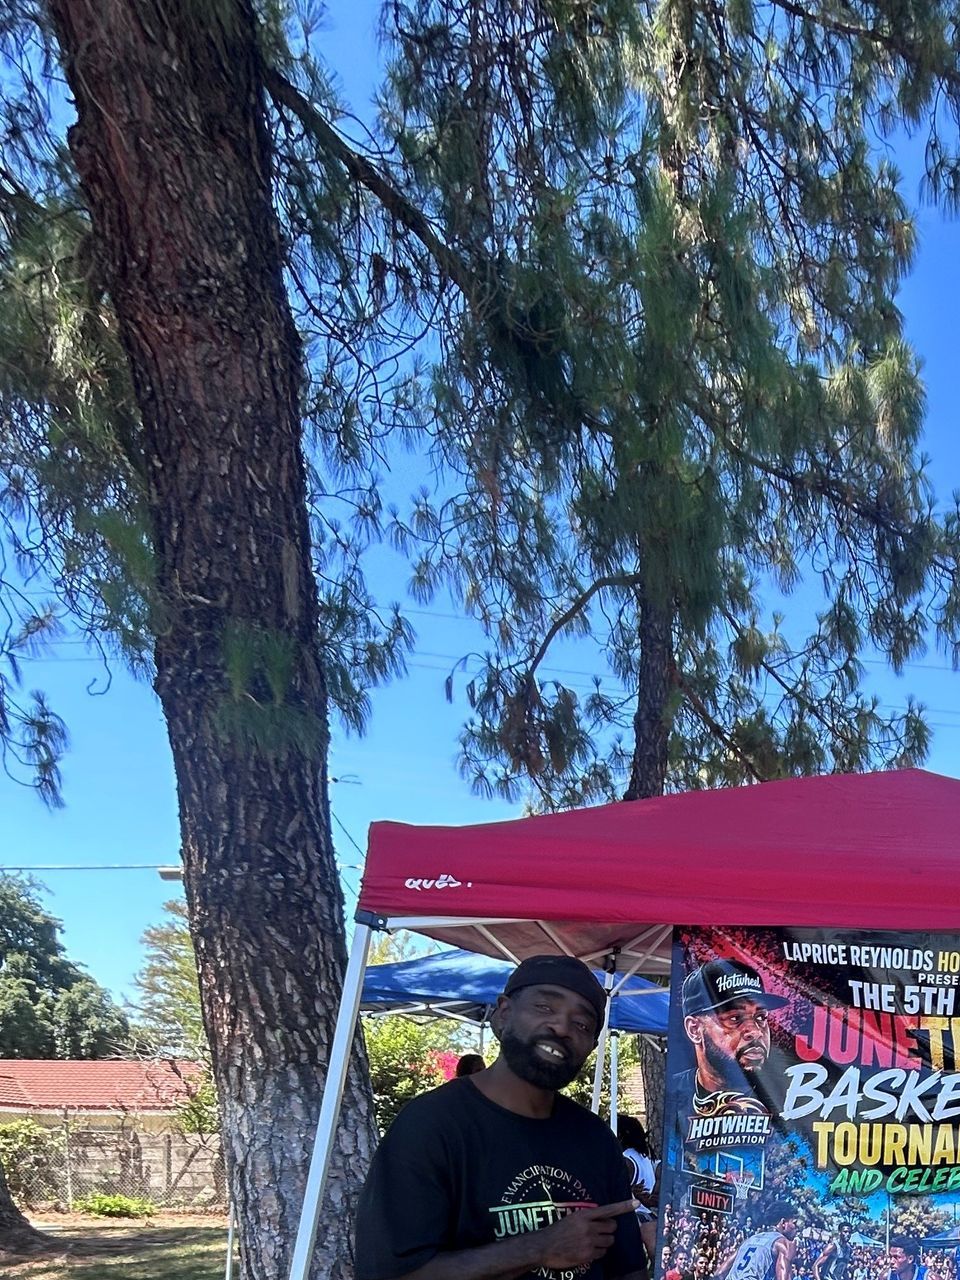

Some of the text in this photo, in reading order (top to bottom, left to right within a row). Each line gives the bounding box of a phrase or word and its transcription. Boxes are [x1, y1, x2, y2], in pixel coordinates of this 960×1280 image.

[783, 942, 848, 965] LAPRICE
[851, 945, 933, 971] REYNOLDS
[848, 980, 895, 1013] THE
[904, 985, 955, 1016] 5TH
[690, 1115, 771, 1139] HOTWHEEL
[699, 1135, 765, 1149] FOUNDATION
[501, 1164, 573, 1204] EMANCIPATION
[830, 1168, 883, 1194] AND
[695, 1190, 730, 1211] UNITY
[737, 1247, 757, 1271] 5
